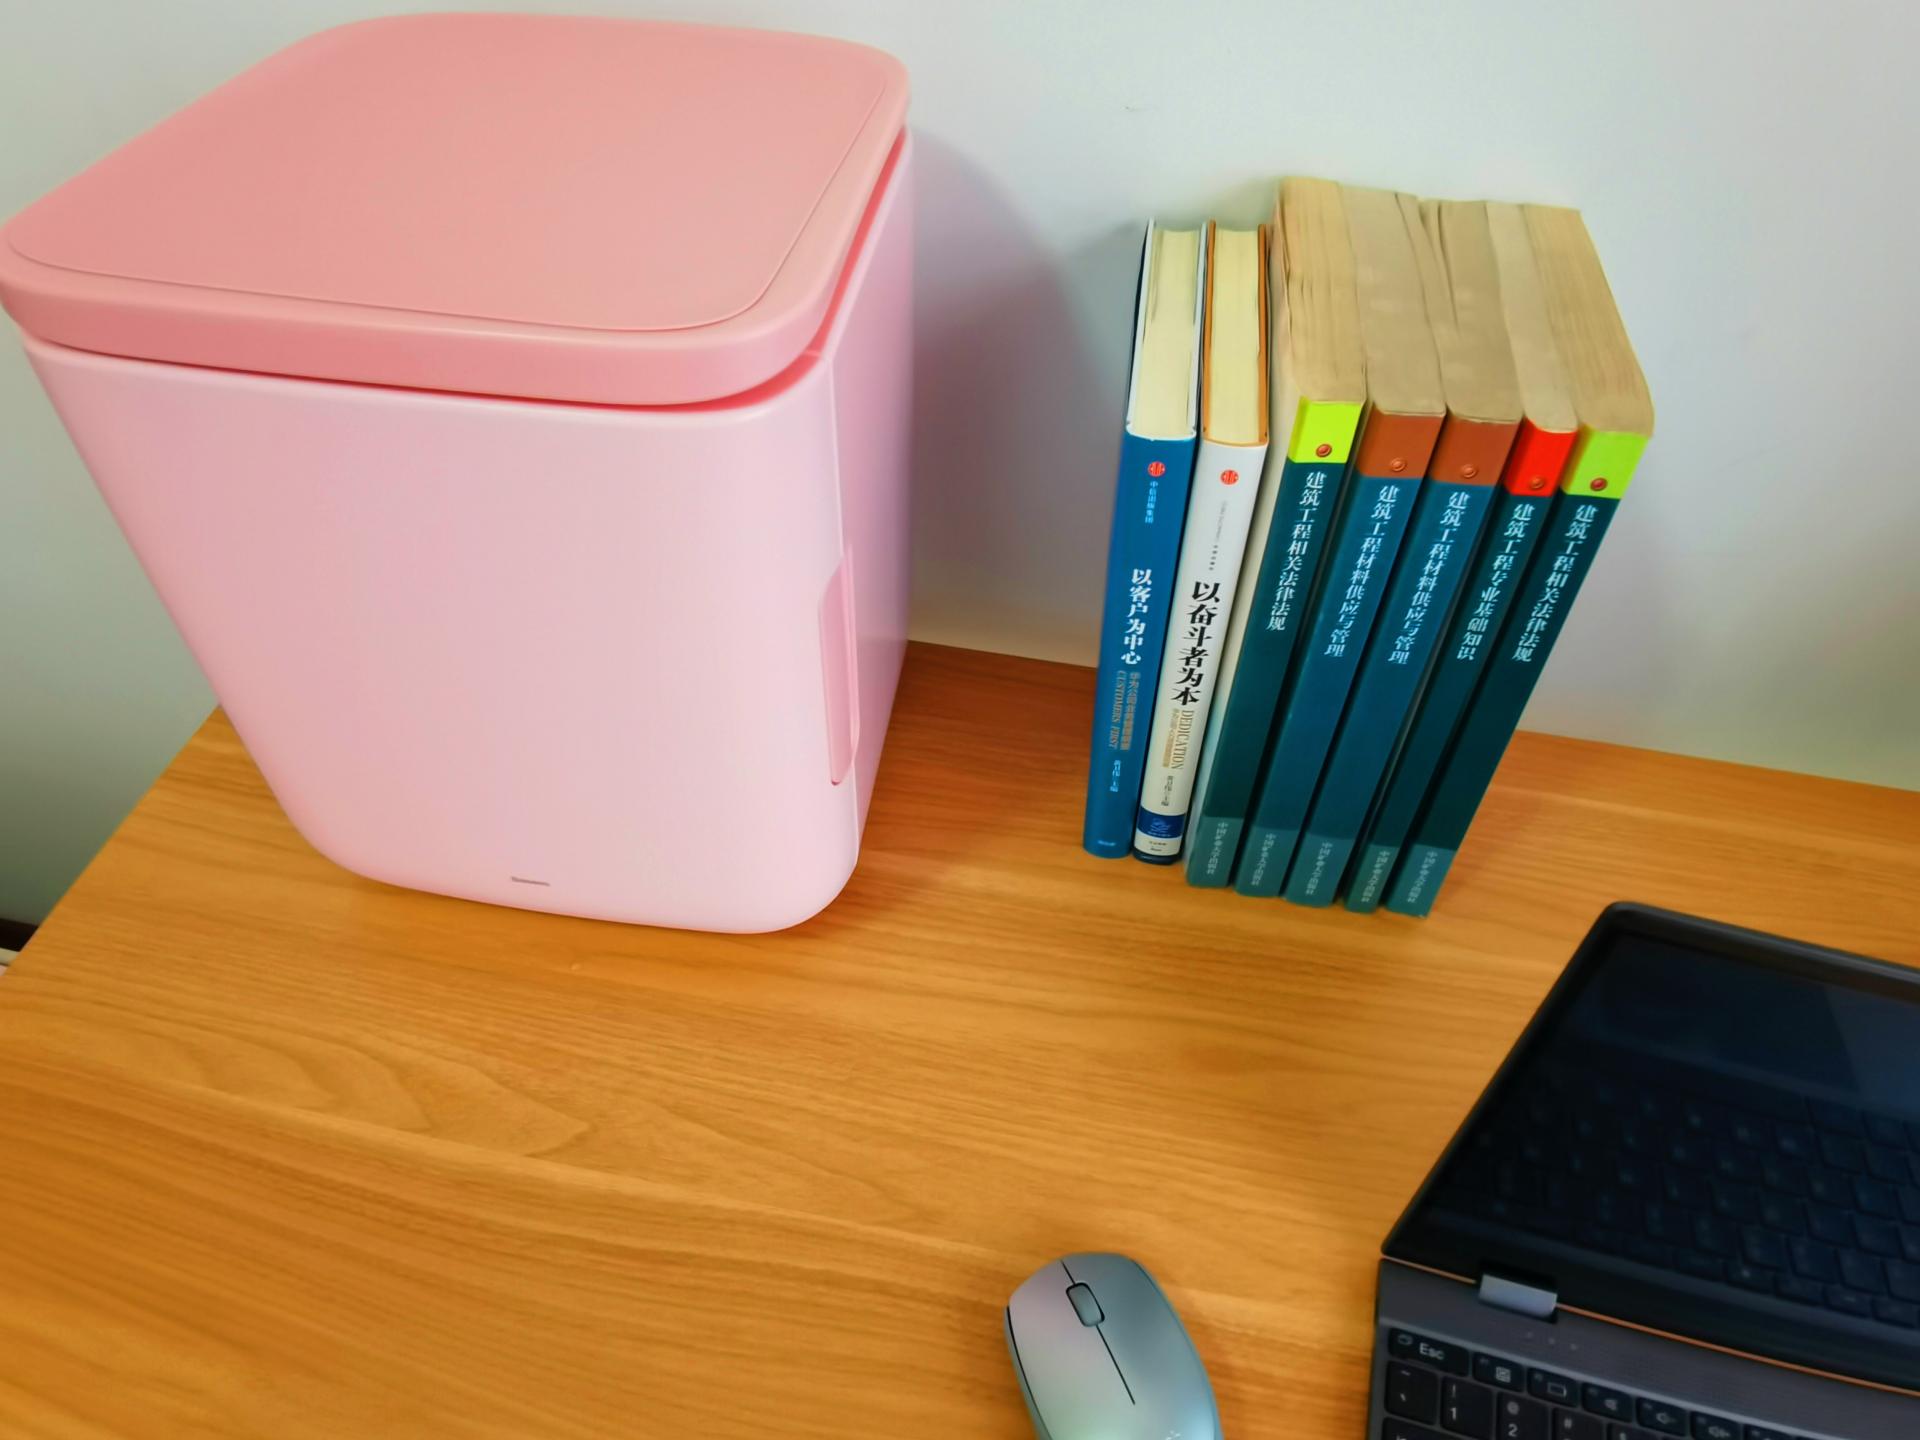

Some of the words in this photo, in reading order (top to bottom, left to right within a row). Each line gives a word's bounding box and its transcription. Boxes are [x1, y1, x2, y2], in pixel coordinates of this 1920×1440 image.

[1266, 471, 1327, 631] 建筑工程相关法律法规
[1324, 484, 1400, 658] 建筑工程材料供应与管理
[1388, 491, 1471, 665] 建筑工程材料供应与管理
[1456, 503, 1535, 661] 建筑工程专业基础知识
[1511, 504, 1598, 663] 建筑工程相关法律法规
[1121, 568, 1152, 665] 以客户为中心
[1170, 580, 1221, 706] 以奋斗者为本
[1172, 710, 1195, 770] DEDICATION
[1419, 1343, 1445, 1360] Esc
[1449, 1407, 1457, 1421] 1
[1508, 1423, 1519, 1438] 2
